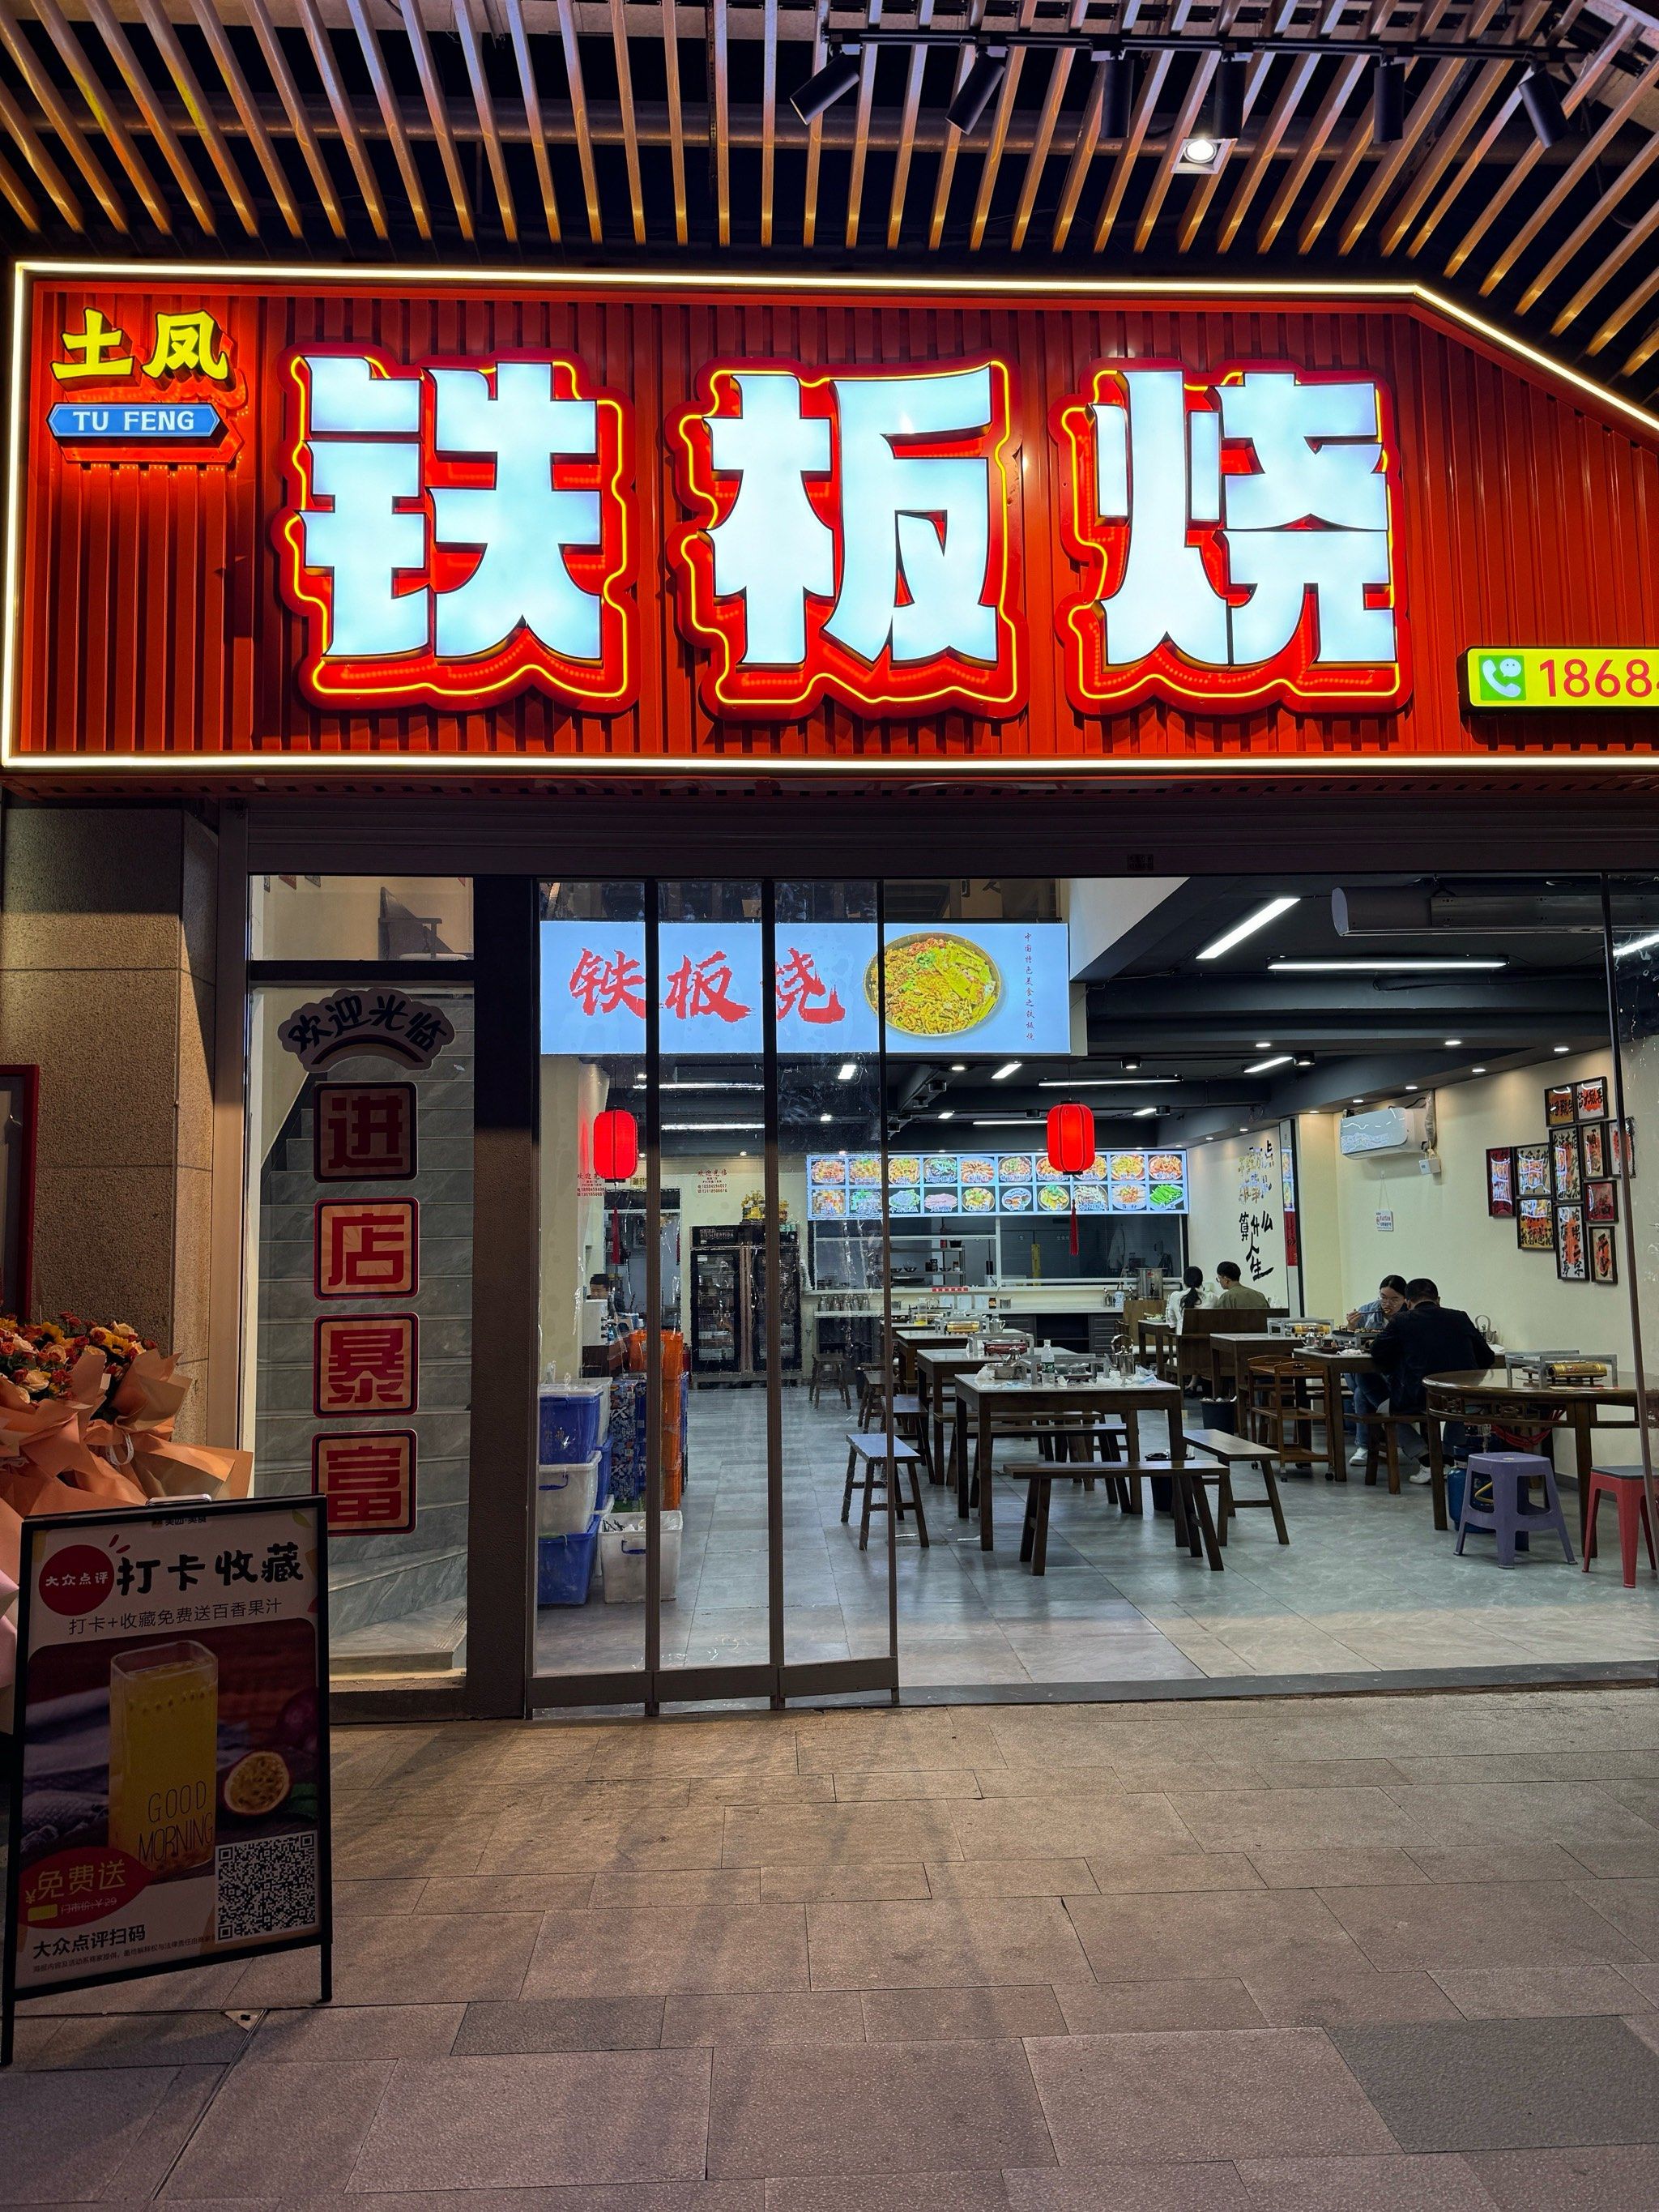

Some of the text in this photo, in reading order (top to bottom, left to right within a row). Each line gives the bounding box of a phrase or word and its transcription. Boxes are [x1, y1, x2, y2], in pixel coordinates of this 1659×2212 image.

[51, 306, 230, 382] 土凤
[73, 411, 195, 432] TU FENG
[298, 357, 1398, 668] 铁板烧
[1539, 659, 1659, 698] 1868
[569, 946, 846, 1024] 铁板烧
[287, 994, 447, 1053] 欢迎光临
[326, 1095, 404, 1523] 进店暴富
[45, 1571, 109, 1587] 大众点评
[116, 1542, 304, 1596] 打卡收藏
[68, 1597, 283, 1636] 打卡+收藏免费送百香果汁
[147, 1780, 207, 1823] GOOD
[139, 1813, 214, 1863] MORNING
[33, 1924, 147, 1960] 大众点评扫码
